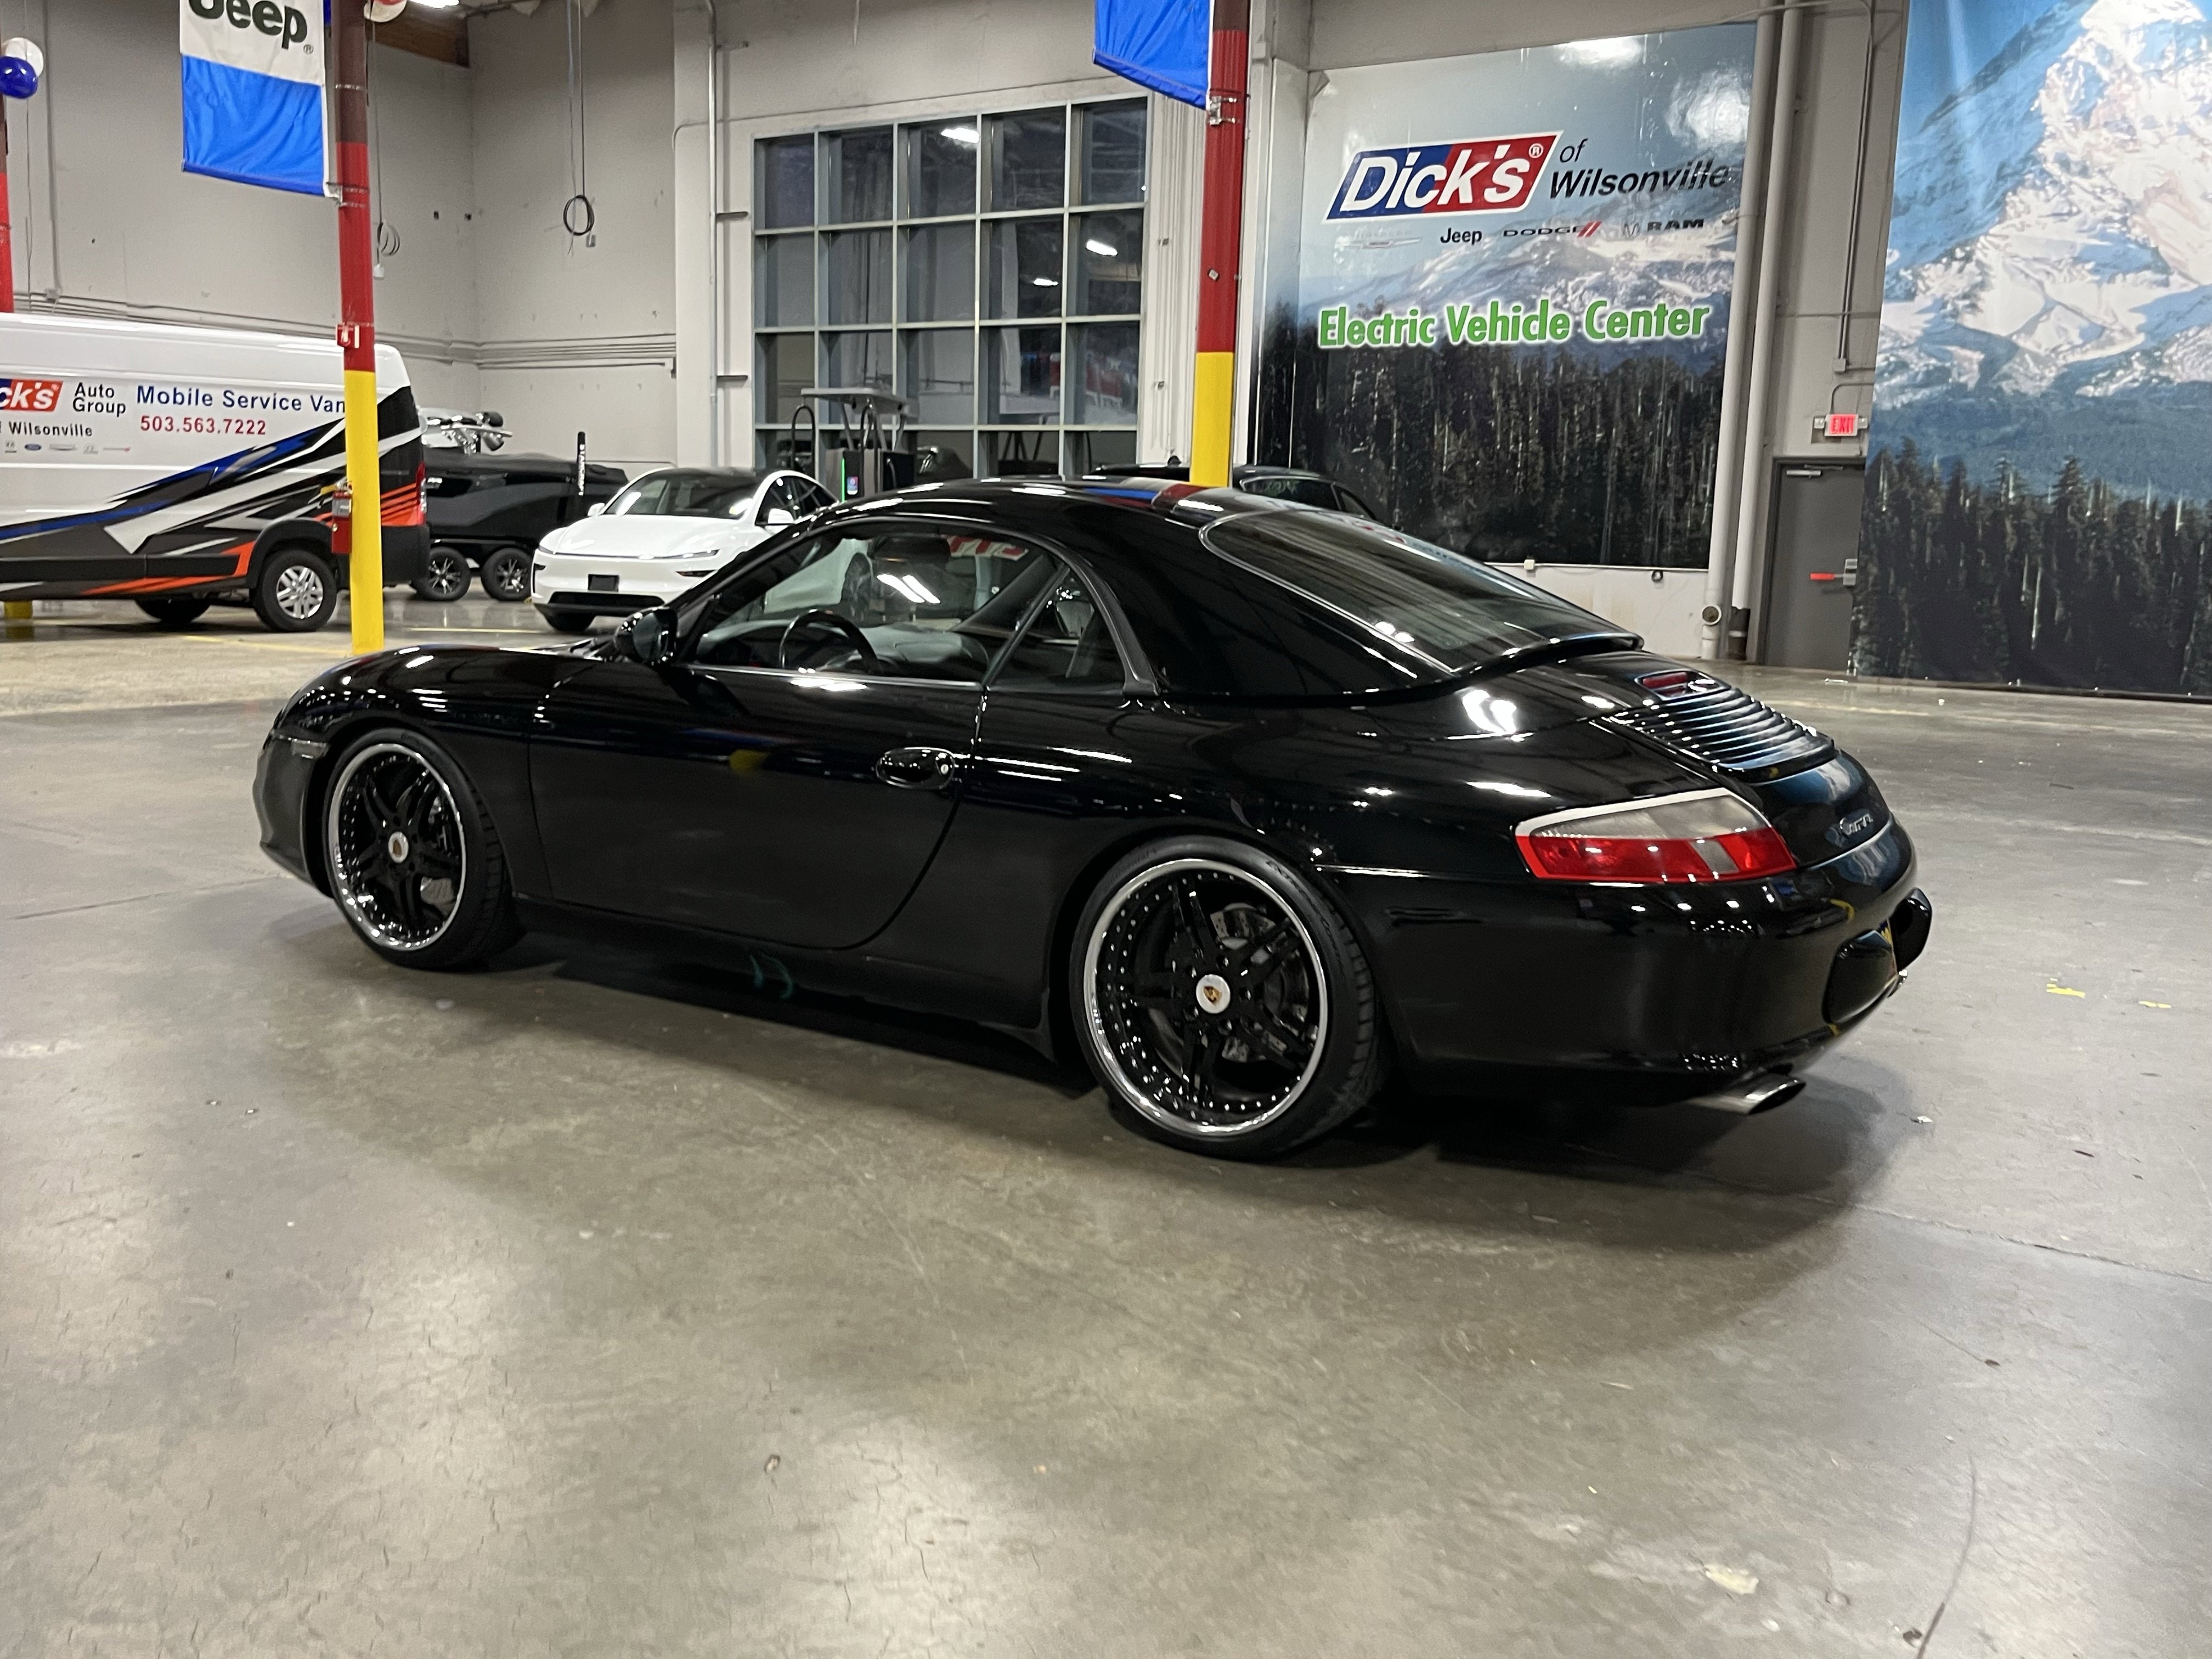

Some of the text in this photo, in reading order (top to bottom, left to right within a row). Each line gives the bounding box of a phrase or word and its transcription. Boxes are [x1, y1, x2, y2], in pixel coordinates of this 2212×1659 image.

[1559, 138, 1588, 163] of
[1339, 144, 1531, 212] Dick's
[1550, 157, 1729, 199] Wilsonville
[1440, 228, 1482, 245] Jeep
[1647, 219, 1704, 232] RAM
[1319, 300, 1710, 347] Electric Vehicle Center
[0, 381, 54, 409] ck's
[74, 382, 115, 398] Auto
[137, 386, 345, 413] Mobile Service Van
[72, 397, 126, 417] Group
[9, 421, 93, 437] Wilsonville
[140, 415, 266, 435] 503.563.7222
[1832, 417, 1854, 433] EXIT
